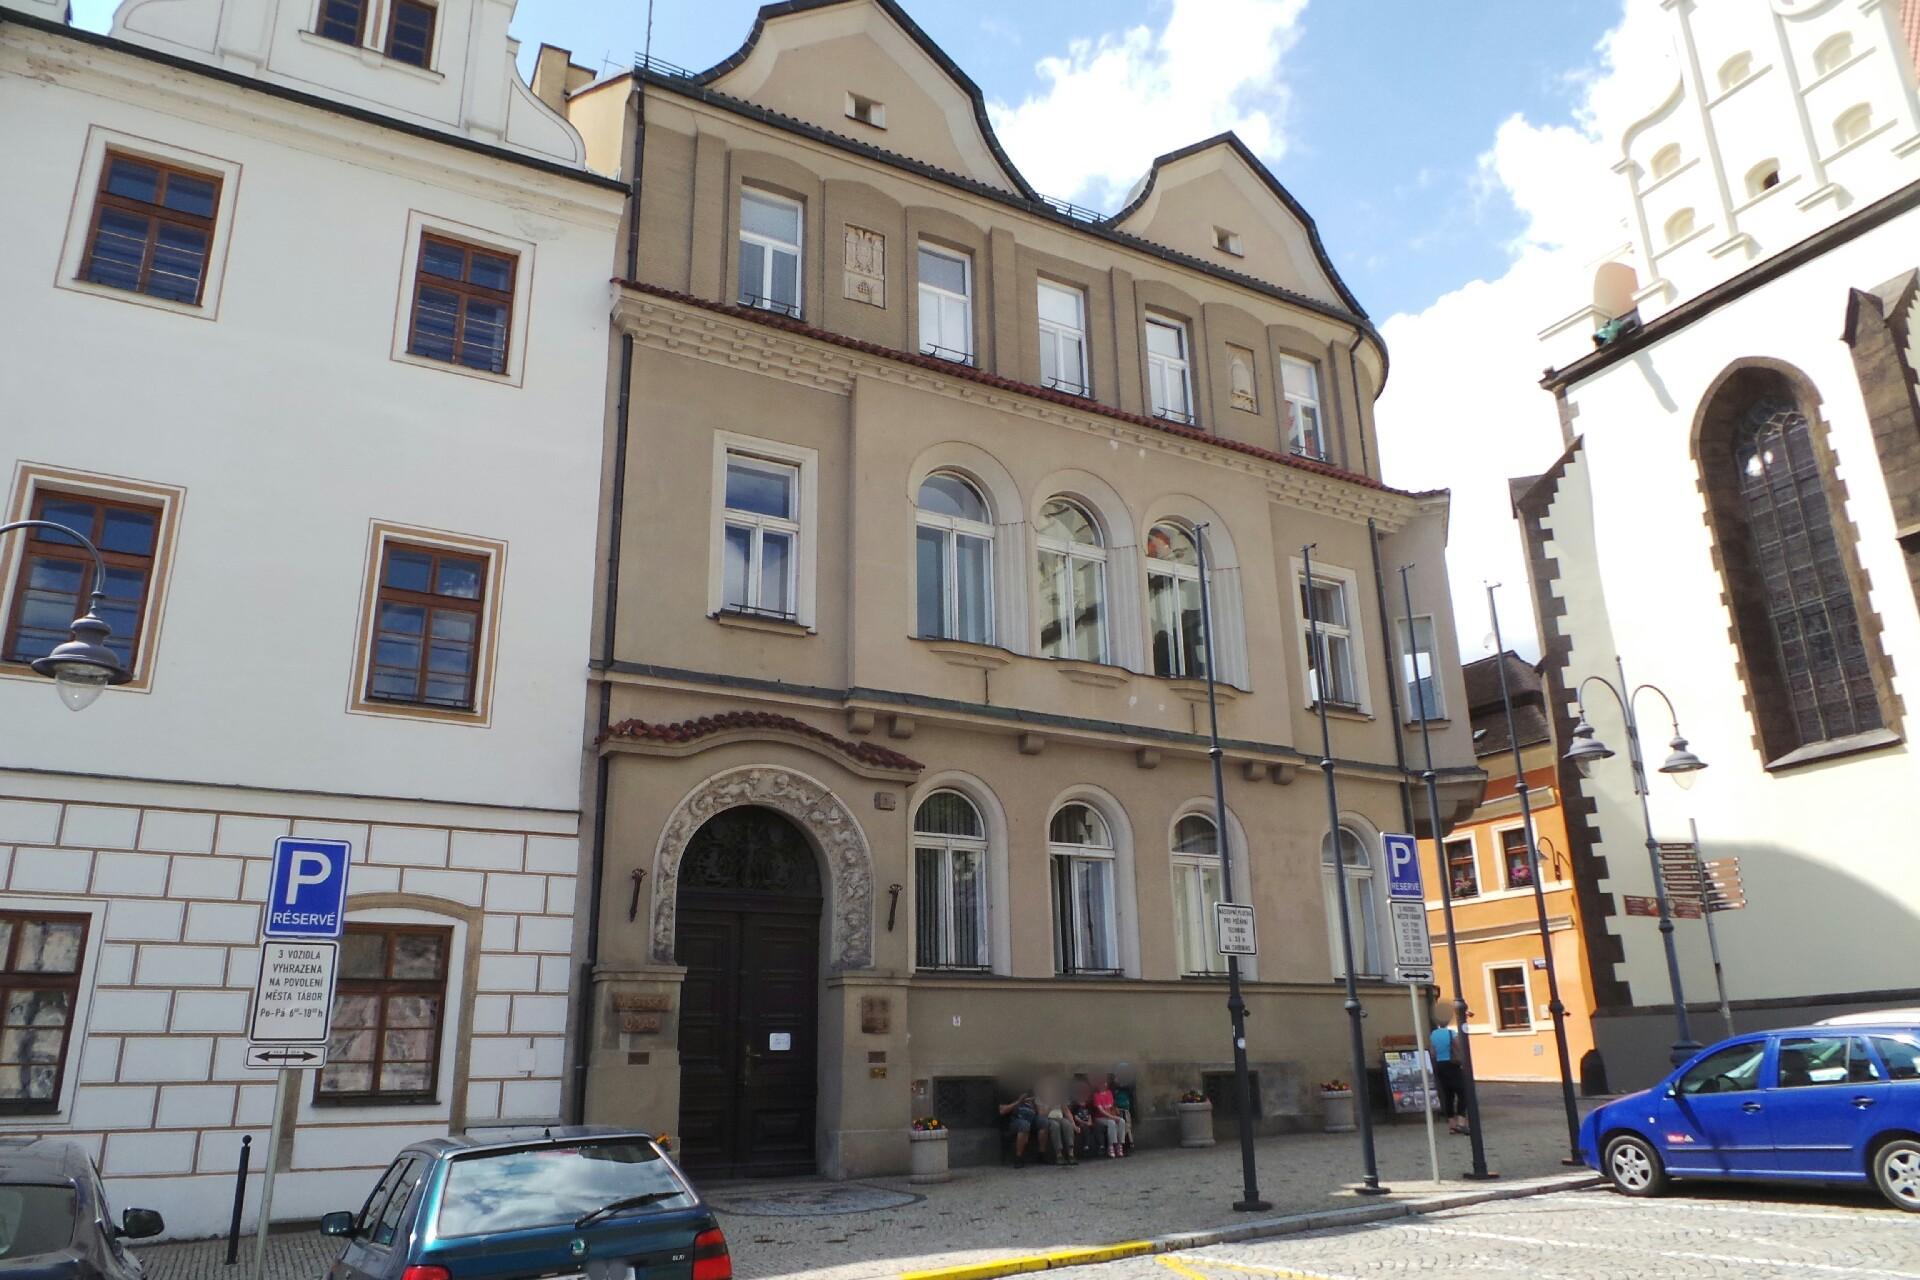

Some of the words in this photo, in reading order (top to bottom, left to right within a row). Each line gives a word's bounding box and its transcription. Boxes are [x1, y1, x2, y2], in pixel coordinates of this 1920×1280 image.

[1390, 841, 1411, 878] P
[285, 850, 332, 905] P
[272, 909, 336, 926] RÉSERVÉ
[278, 949, 284, 959] 3
[288, 950, 321, 960] VOZIDLA
[273, 963, 322, 974] VYHRAZENA
[269, 978, 281, 987] NA
[265, 989, 292, 1001] MĚSTA
